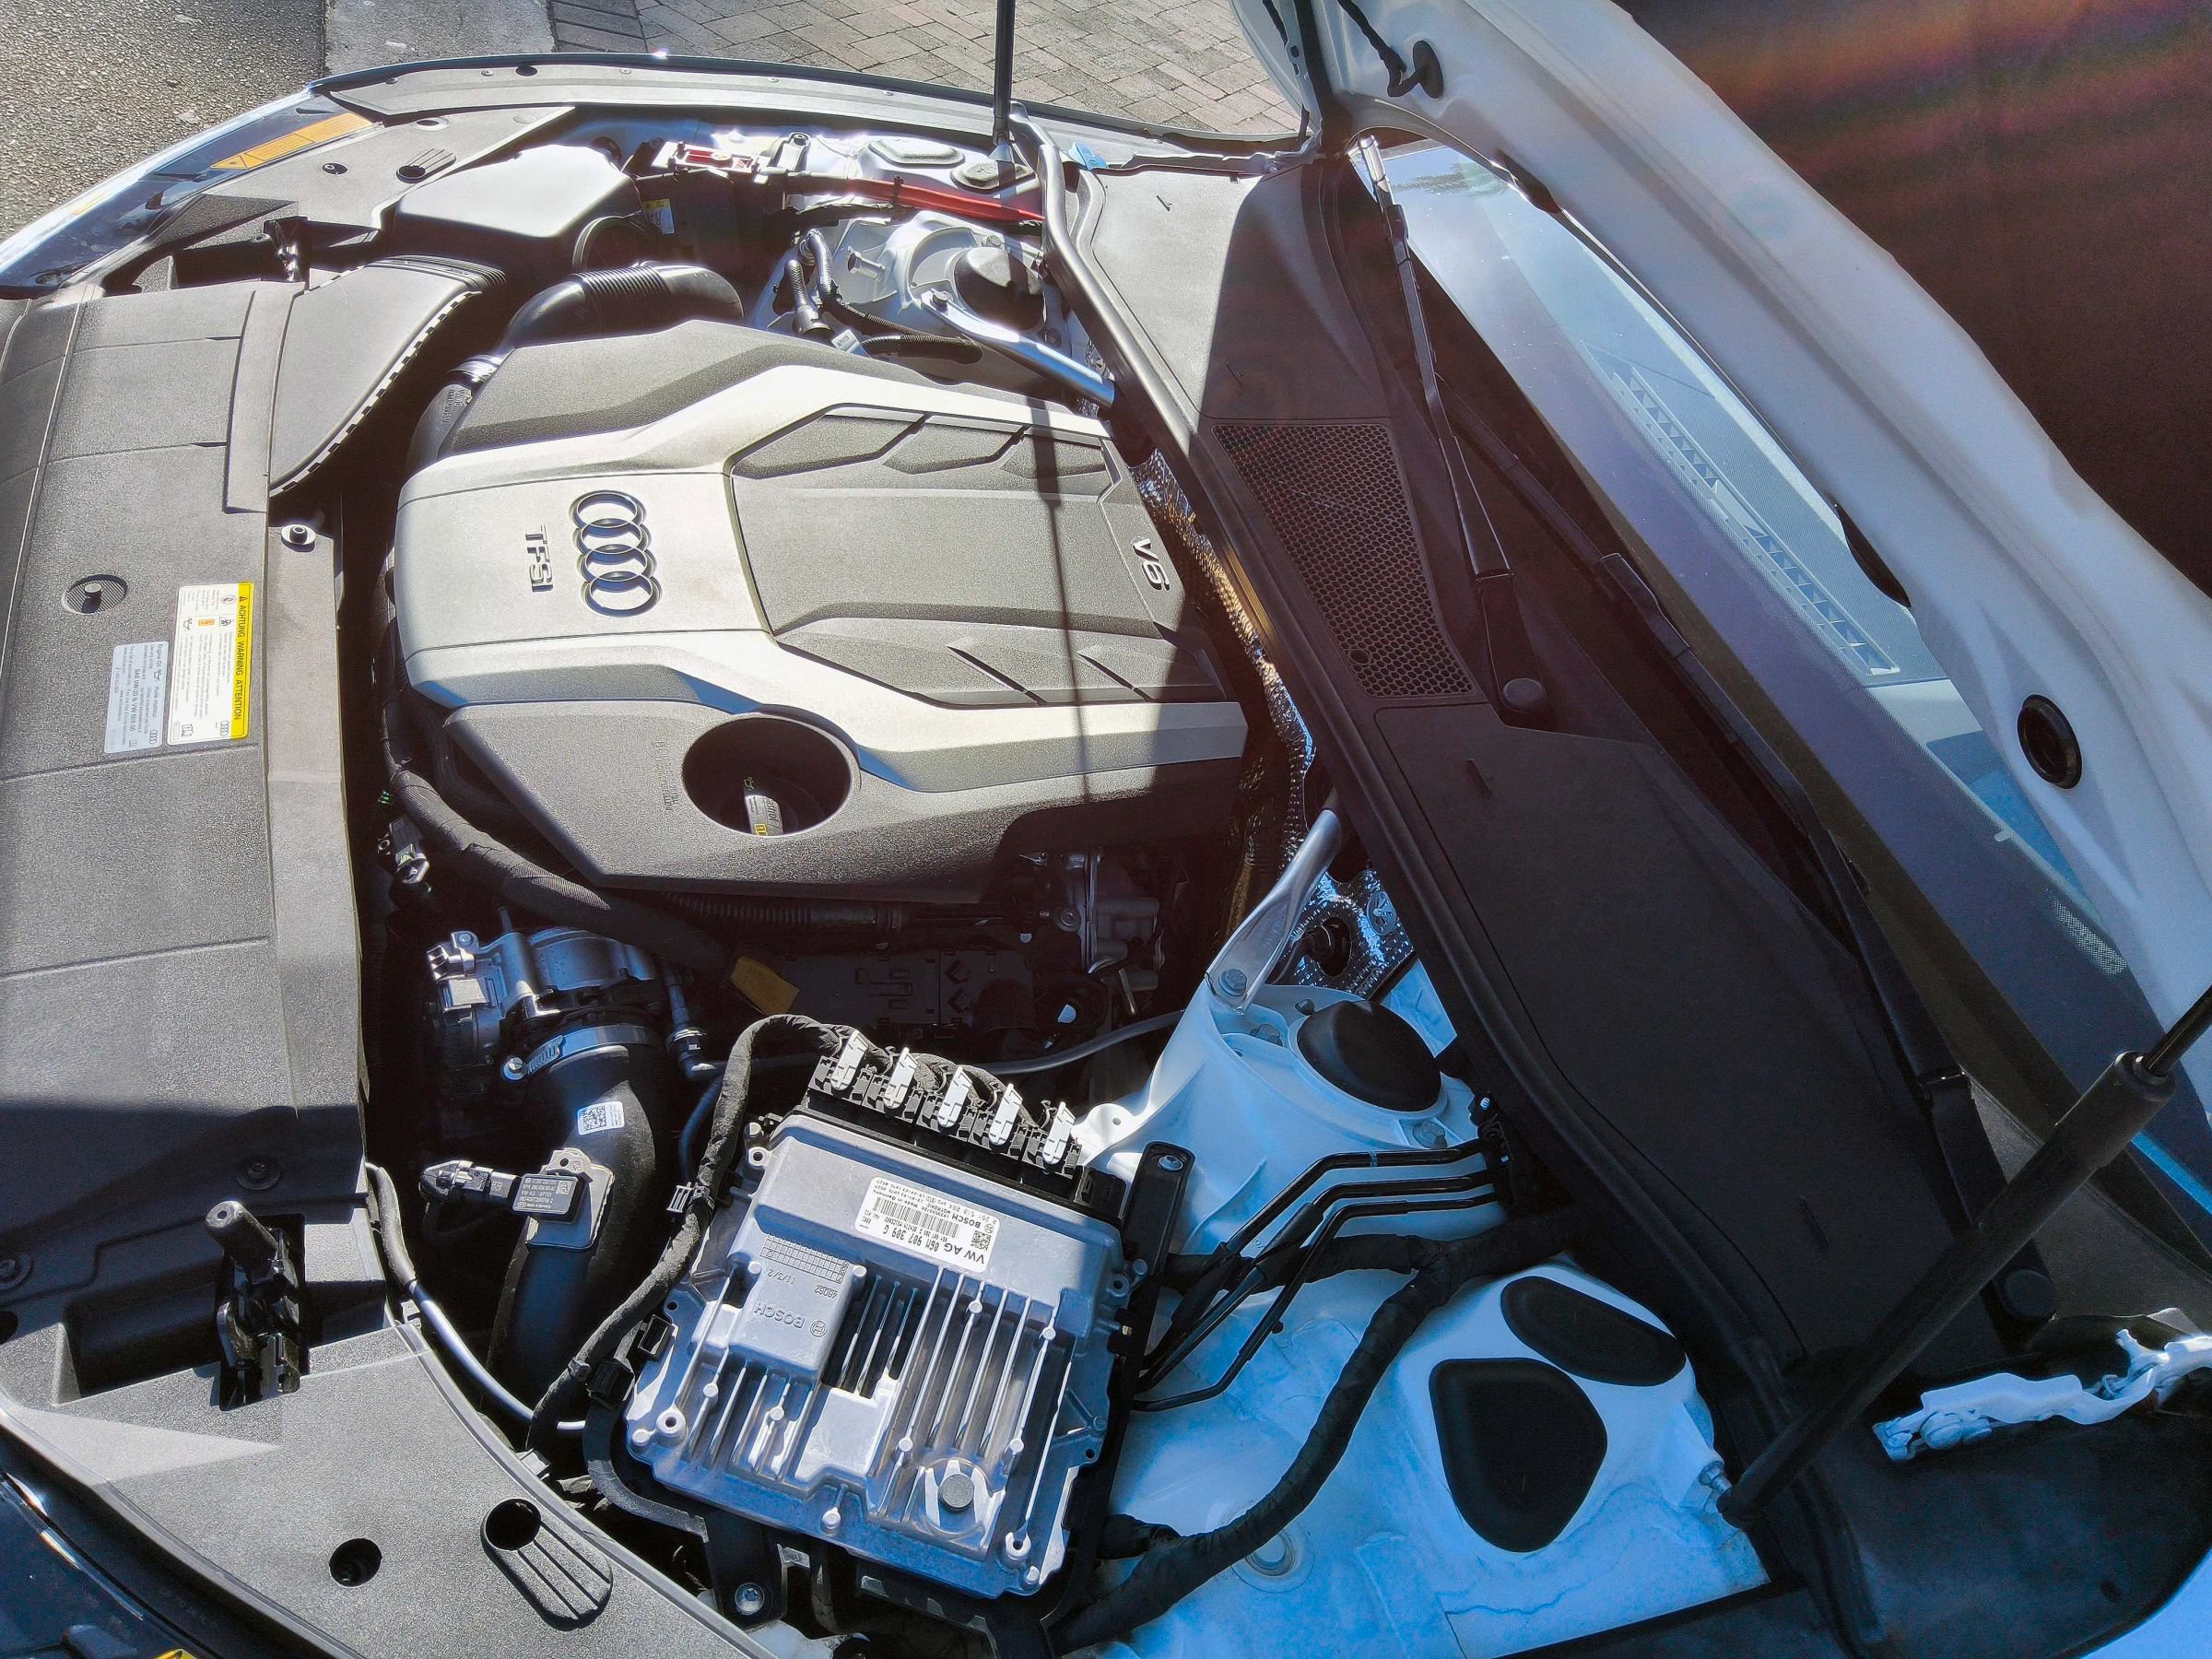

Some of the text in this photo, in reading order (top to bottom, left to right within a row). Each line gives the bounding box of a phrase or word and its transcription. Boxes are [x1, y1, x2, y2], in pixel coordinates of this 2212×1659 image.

[525, 524, 553, 592] TFSI
[1132, 537, 1170, 592] V6
[236, 641, 244, 676] WARNING
[234, 679, 242, 720] ATTENTION
[765, 798, 779, 824] astrol
[926, 1203, 951, 1215] MOTRONIC
[951, 1213, 981, 1229] BOSCH
[882, 1224, 986, 1265] VW AG 06M 907 309 G
[754, 1302, 805, 1329] BOSCH
